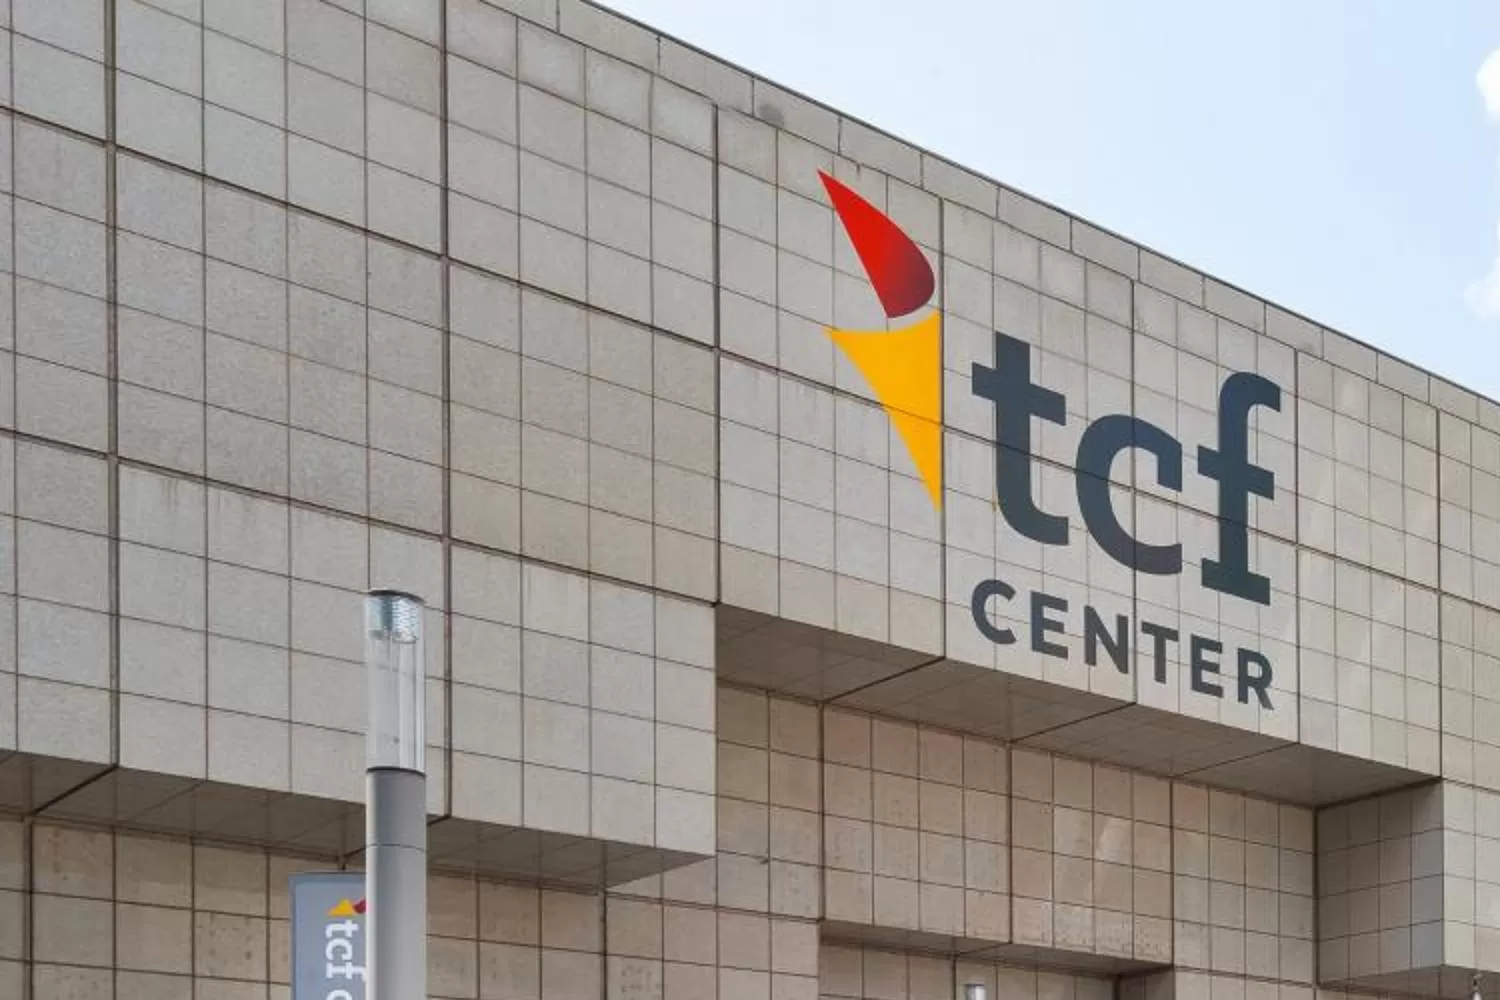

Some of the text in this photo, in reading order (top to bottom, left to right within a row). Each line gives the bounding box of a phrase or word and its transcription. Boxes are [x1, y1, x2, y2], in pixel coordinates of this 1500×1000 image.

[971, 331, 1281, 606] tcf
[971, 578, 1274, 710] CENTER
[325, 920, 366, 982] tcf
